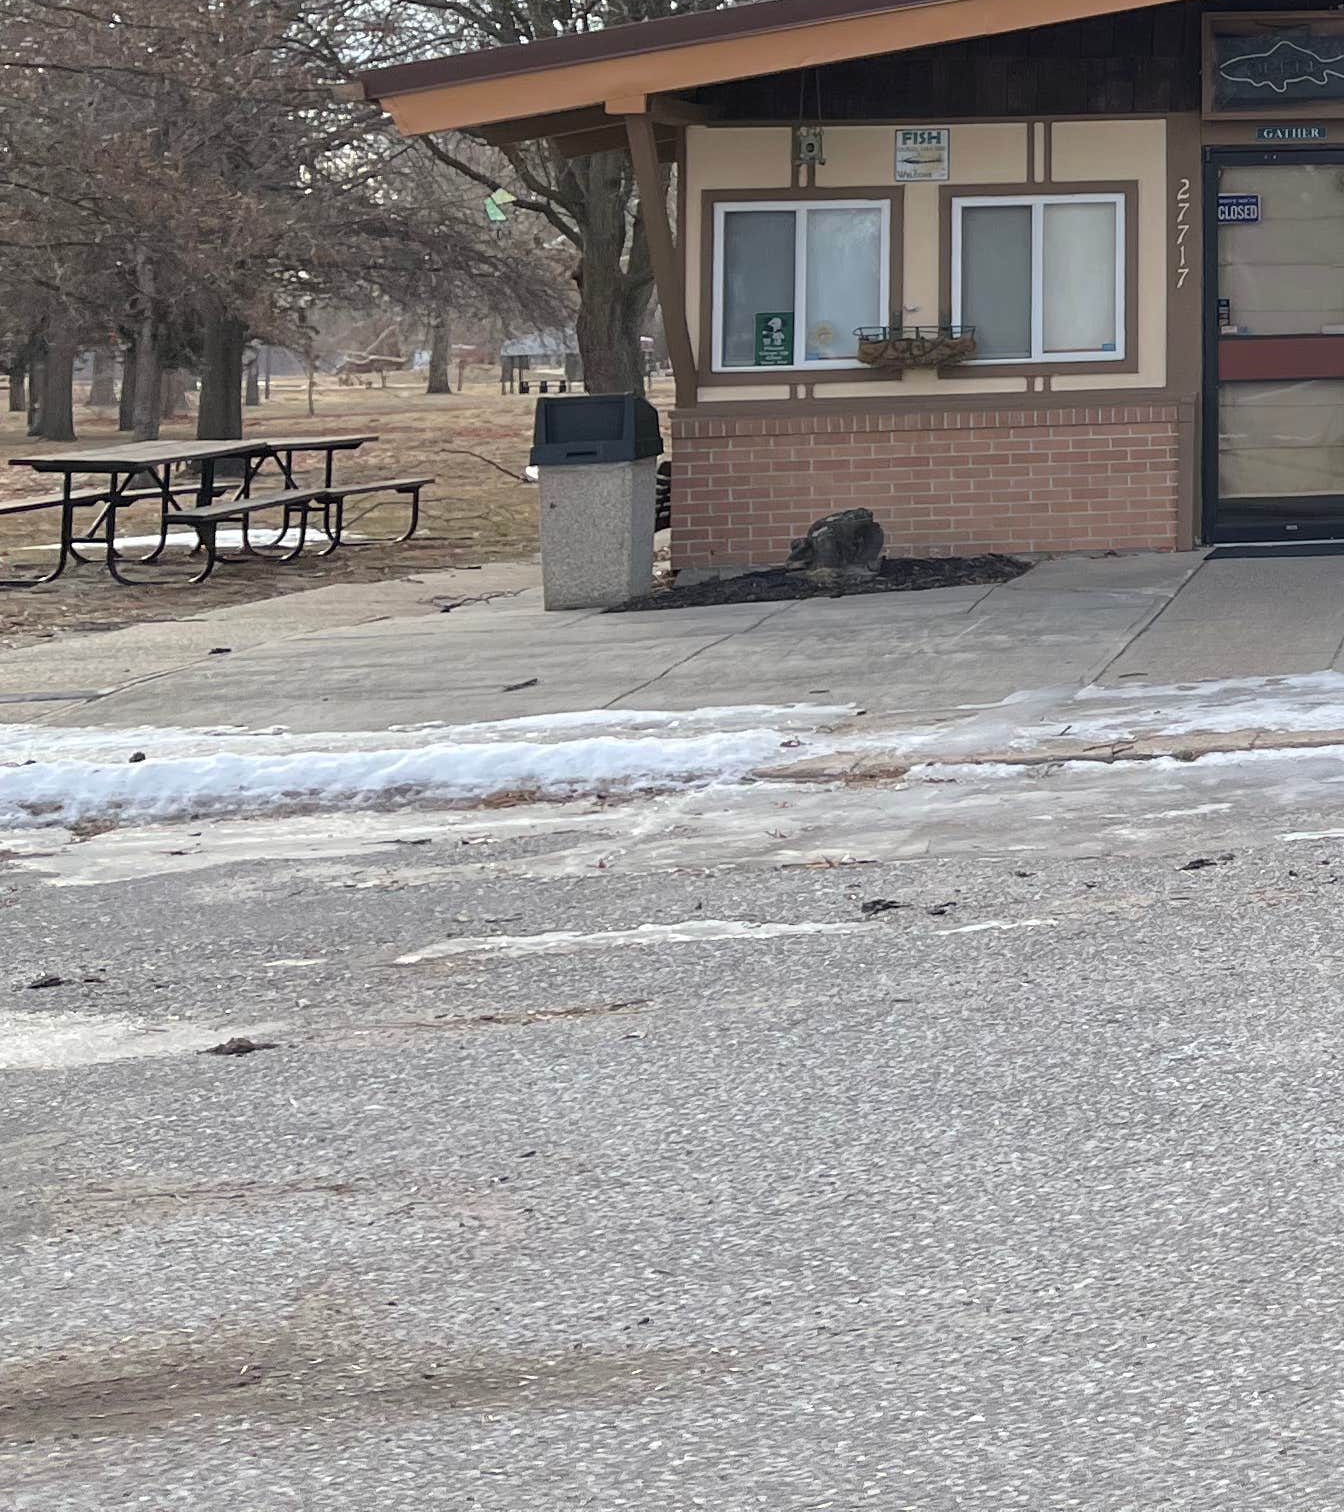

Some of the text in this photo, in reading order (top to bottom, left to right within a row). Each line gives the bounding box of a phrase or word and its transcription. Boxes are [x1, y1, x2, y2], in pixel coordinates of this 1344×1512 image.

[902, 131, 942, 145] FISH
[1263, 128, 1320, 139] GATHER
[1217, 205, 1258, 220] CLOSED
[1176, 178, 1190, 289] 27717
